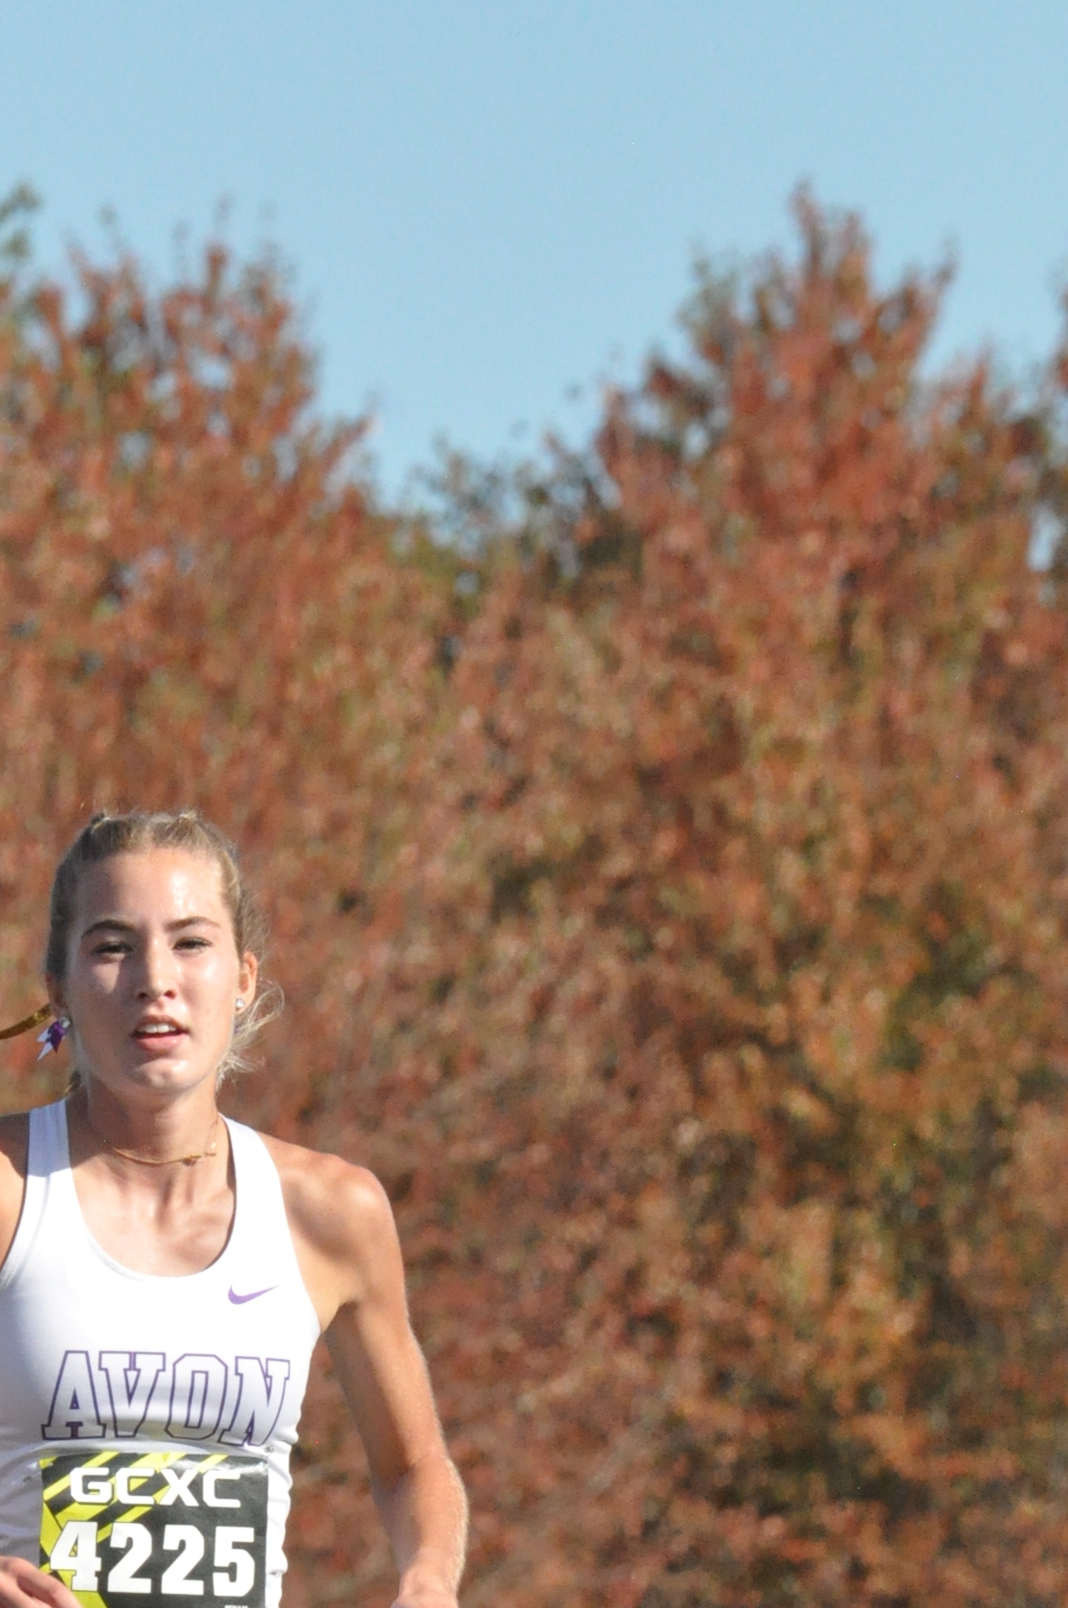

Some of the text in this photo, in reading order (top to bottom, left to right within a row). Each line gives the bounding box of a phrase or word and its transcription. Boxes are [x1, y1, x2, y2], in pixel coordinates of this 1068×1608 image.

[41, 1350, 291, 1447] AVON
[70, 1466, 242, 1508] GCXC
[50, 1520, 255, 1597] 4225
